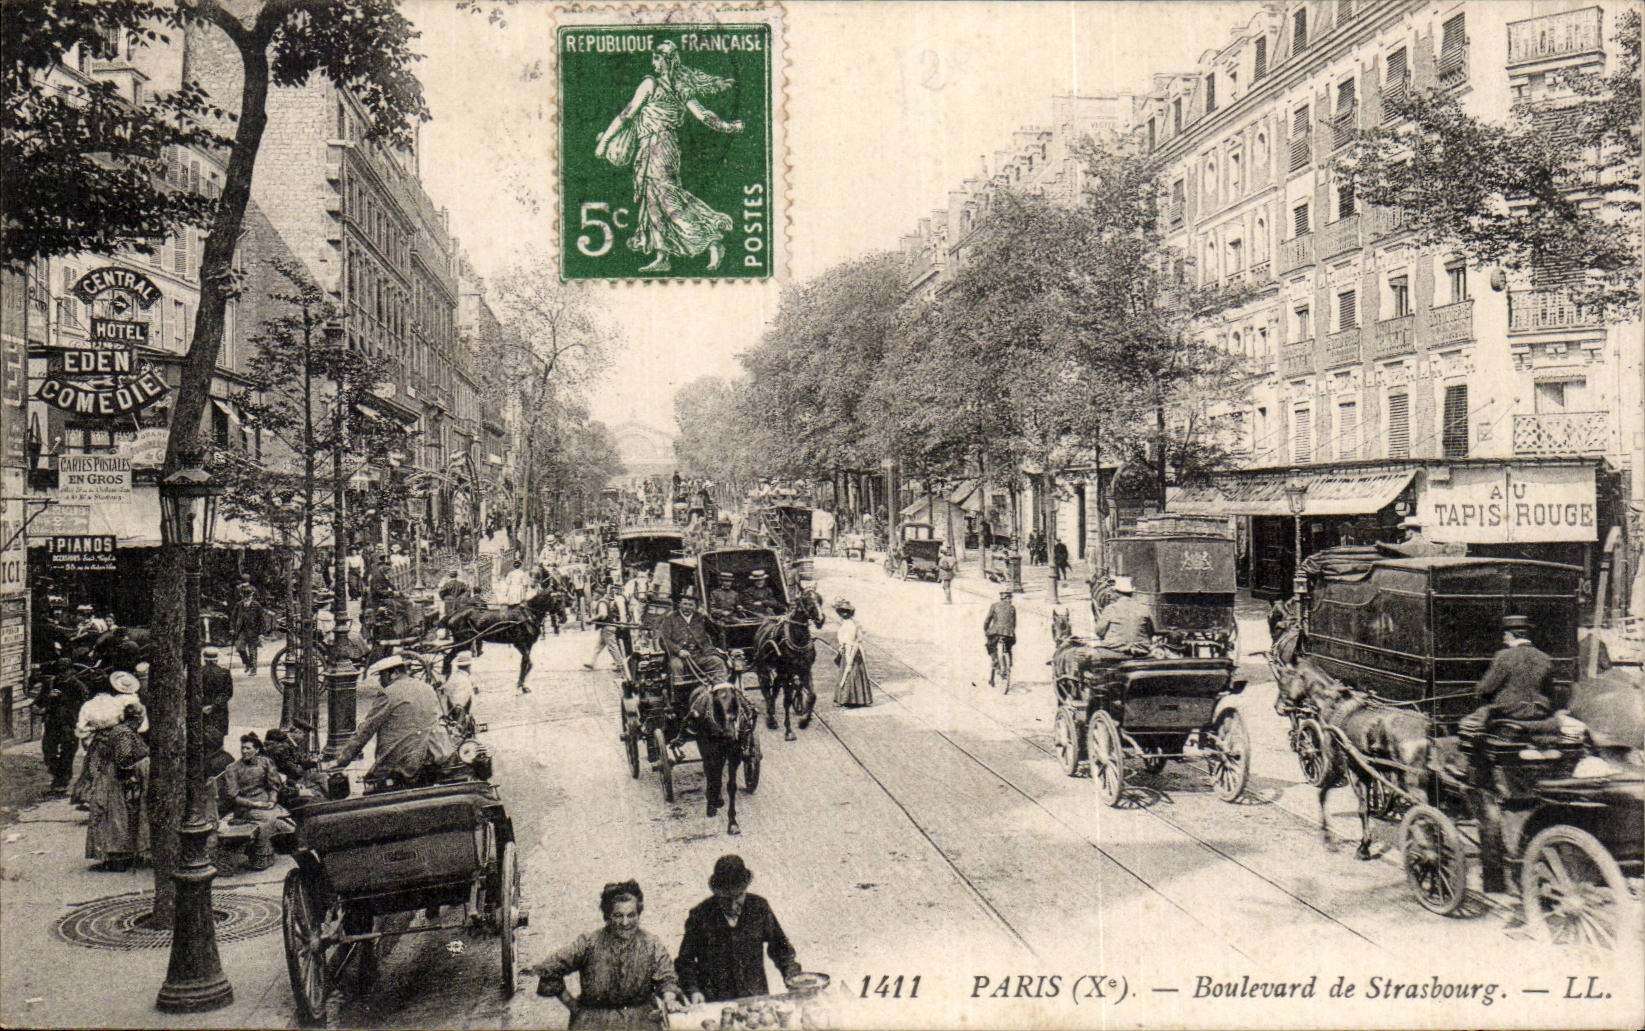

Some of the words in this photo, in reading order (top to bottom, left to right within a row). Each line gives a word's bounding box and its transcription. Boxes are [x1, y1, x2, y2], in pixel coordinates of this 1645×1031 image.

[566, 34, 654, 53] REPUBLIQUE
[681, 34, 762, 54] FRANÇAISE
[744, 183, 763, 268] POSTES
[82, 270, 154, 300] CENTRAL
[96, 321, 145, 340] HOTEL
[64, 351, 129, 372] EDEN
[41, 373, 161, 414] COMEDIE
[60, 457, 92, 472] CARTES
[94, 457, 131, 472] POSTALES
[68, 474, 85, 485] EN
[87, 473, 124, 485] GROS
[1489, 483, 1527, 500] AU
[1434, 503, 1502, 527] TAPIS
[1515, 503, 1594, 527] ROUGE
[57, 537, 113, 553] PIANOS
[1, 560, 20, 584] ICI
